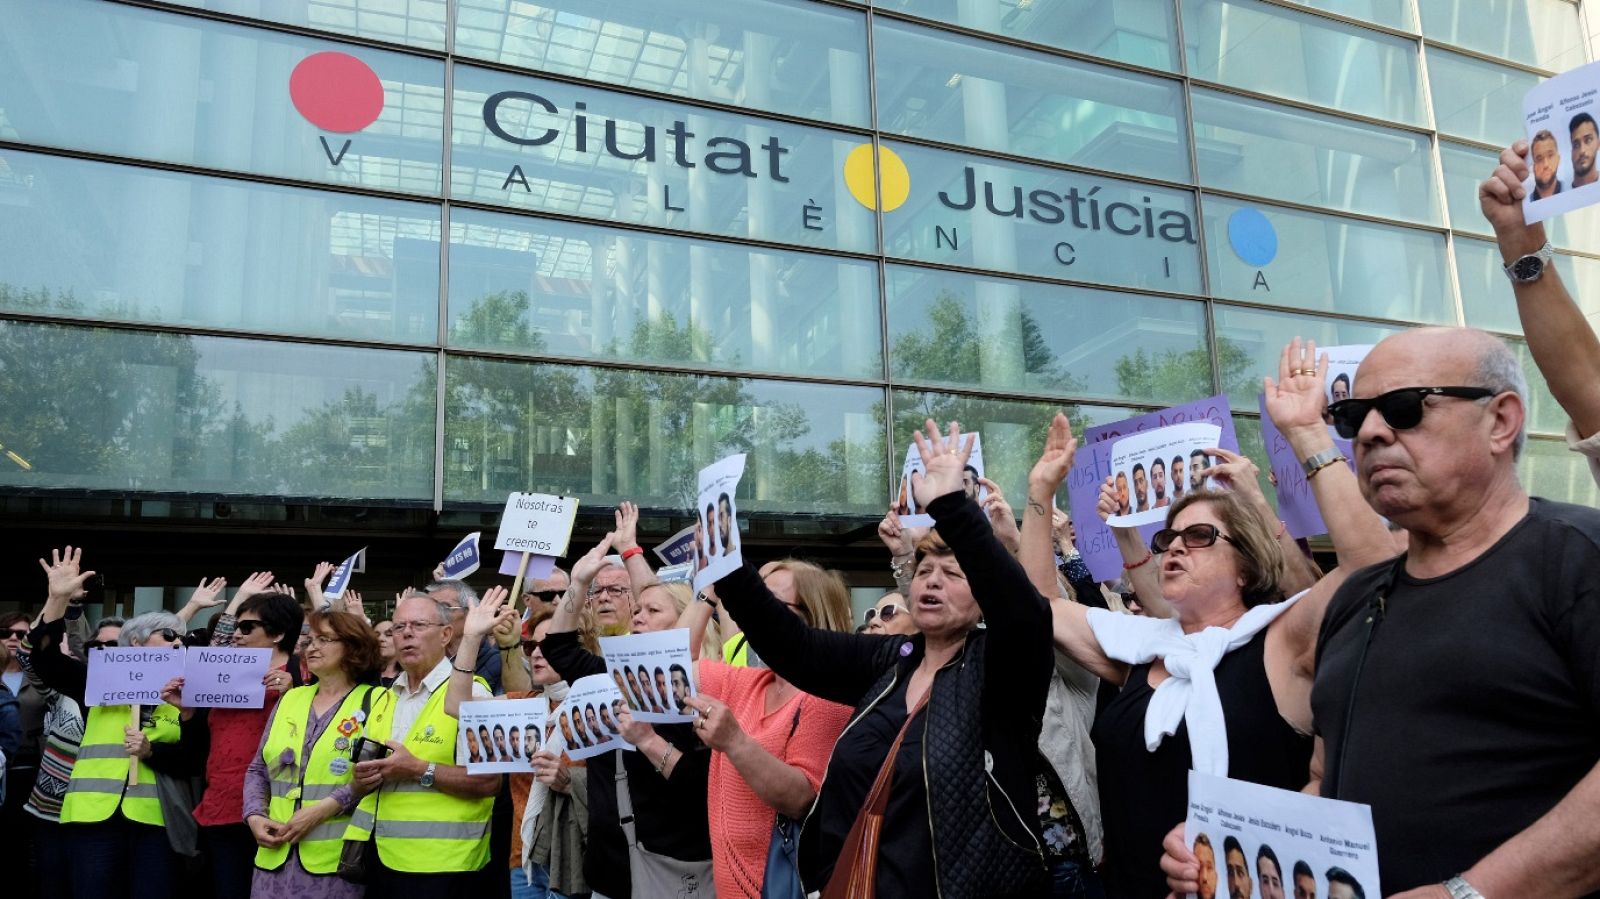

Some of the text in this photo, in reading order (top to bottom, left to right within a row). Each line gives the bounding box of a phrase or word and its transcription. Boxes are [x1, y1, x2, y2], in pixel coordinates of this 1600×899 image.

[482, 90, 1198, 245] Ciutat Justícia
[515, 498, 564, 514] Nosotras
[527, 520, 538, 529] te
[506, 537, 552, 551] creemos
[447, 547, 473, 568] NO ES NO
[104, 651, 170, 664] Nosotras
[198, 651, 258, 664] Nosotras
[129, 670, 144, 681] te
[217, 671, 231, 683] te
[103, 689, 160, 701] creemo
[194, 692, 249, 704] creemos
[1344, 840, 1370, 851] Manuel
